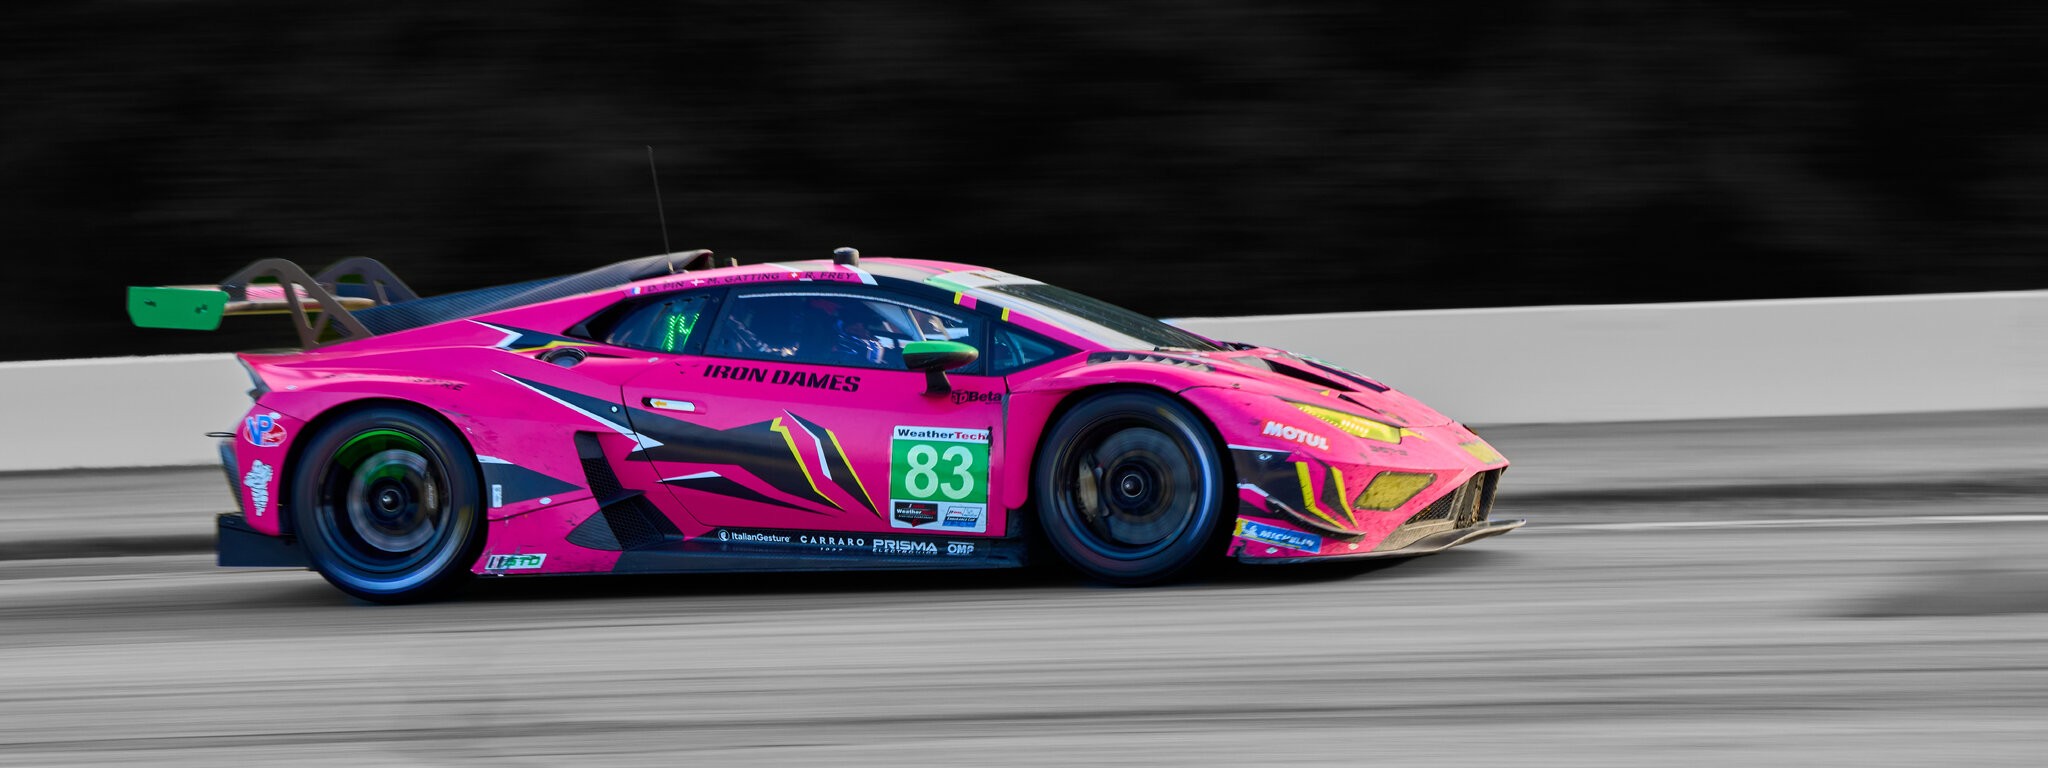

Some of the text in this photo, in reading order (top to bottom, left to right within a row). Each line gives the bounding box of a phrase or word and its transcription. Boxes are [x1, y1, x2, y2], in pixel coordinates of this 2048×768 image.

[724, 272, 780, 284] GATTING
[804, 271, 852, 280] R. FREY
[663, 281, 685, 291] PIN
[703, 364, 861, 393] IRON DAMES
[969, 391, 1002, 402] Beta
[246, 415, 275, 446] VP
[898, 428, 986, 440] WeatherTech
[1263, 421, 1329, 450] MOTUL
[905, 444, 975, 500] 83
[731, 532, 790, 543] ItalianGesture
[800, 535, 865, 547] CARRARO
[1259, 530, 1316, 547] MICHELIN
[872, 539, 938, 551] PRISMA
[947, 543, 975, 555] OMP
